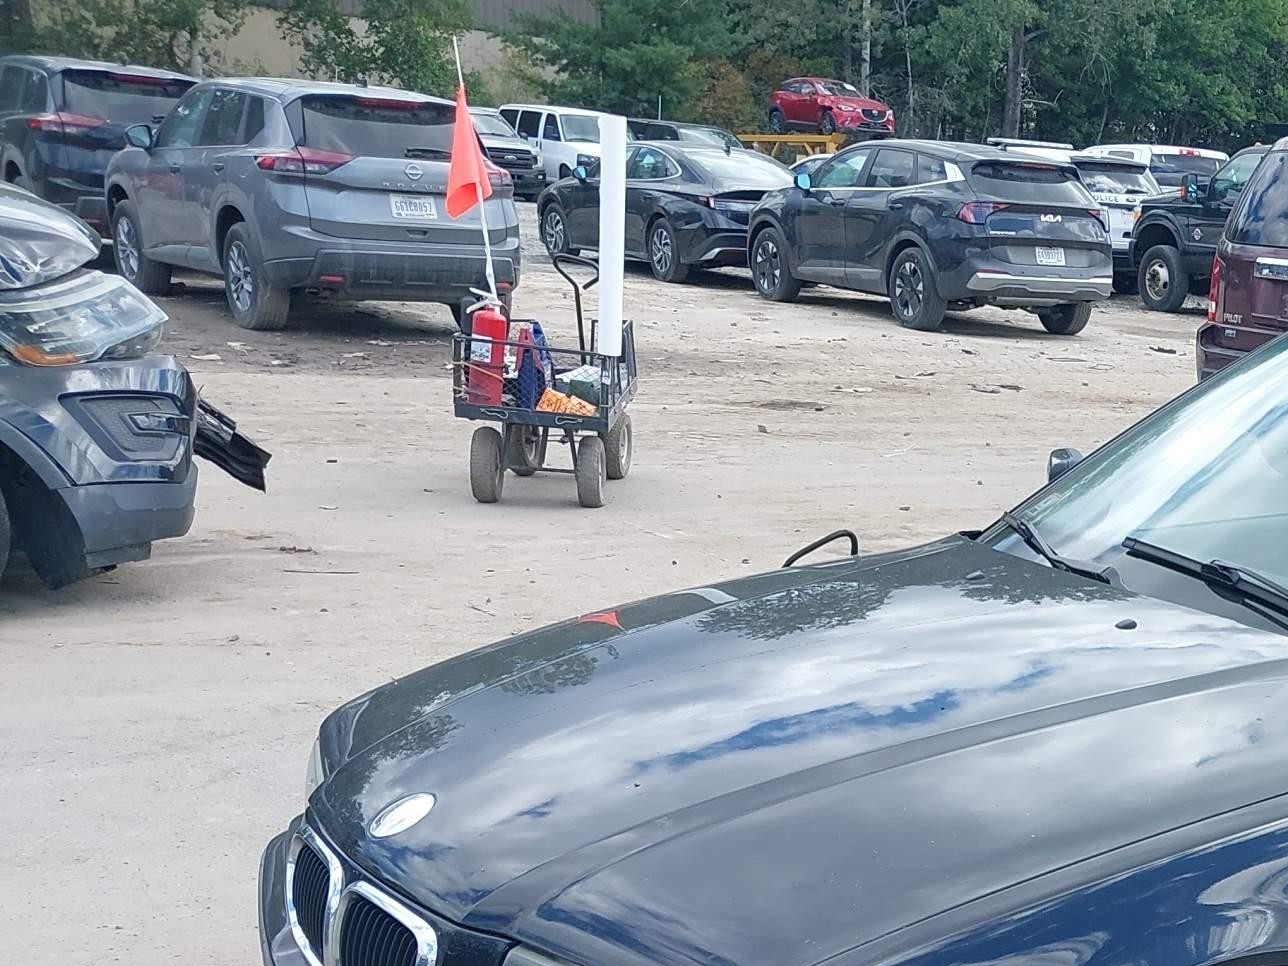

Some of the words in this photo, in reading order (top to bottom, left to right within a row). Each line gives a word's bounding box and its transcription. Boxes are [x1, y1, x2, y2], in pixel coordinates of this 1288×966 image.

[1094, 194, 1119, 203] OLICE
[1040, 213, 1062, 223] KIA
[1223, 313, 1243, 325] PILOT
